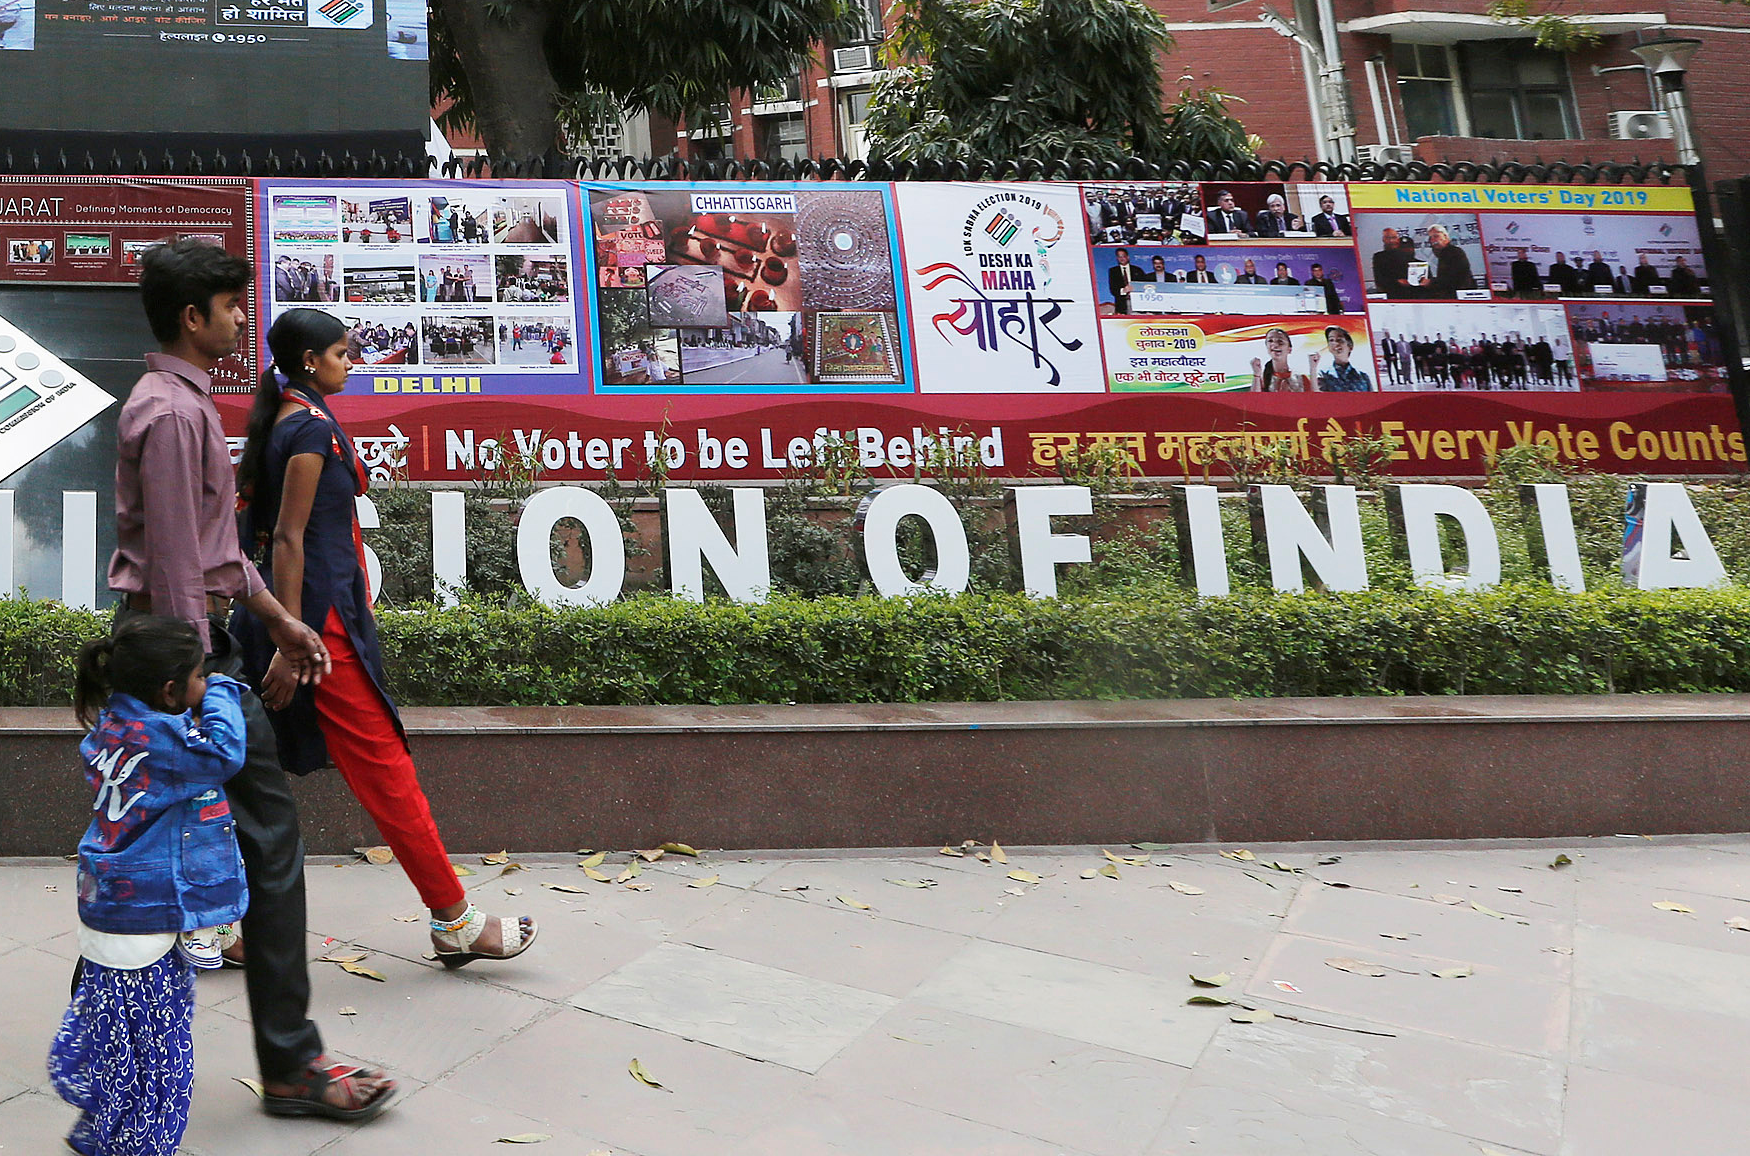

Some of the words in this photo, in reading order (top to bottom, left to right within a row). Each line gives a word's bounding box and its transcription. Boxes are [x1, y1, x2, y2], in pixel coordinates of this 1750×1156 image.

[221, 5, 241, 21] हो
[246, 6, 305, 22] शामिल
[228, 33, 267, 43] 1950
[696, 196, 792, 211] CHHATTISGARH
[977, 193, 1017, 212] ELECTION
[1018, 194, 1042, 211] 2019
[1395, 188, 1480, 203] National
[1560, 189, 1594, 207] Day
[1601, 189, 1647, 205] 2019
[76, 204, 116, 215] Defining
[119, 204, 162, 214] Moments
[165, 204, 175, 214] of
[177, 205, 232, 216] Democracy
[979, 254, 1011, 268] DESH
[1016, 253, 1033, 268] KA
[981, 271, 1036, 291] MAHA
[1139, 325, 1188, 337] लोकसभा
[1136, 338, 1165, 351] चुनाव
[1130, 357, 1148, 368] इस
[373, 376, 482, 393] DELHI
[1115, 372, 1134, 383] एक
[1138, 370, 1151, 381] भी
[1154, 370, 1180, 382] वोटर
[1183, 369, 1205, 388] छूटे
[1207, 372, 1225, 383] ना
[446, 429, 500, 471] No
[514, 428, 632, 471] Voter
[644, 431, 685, 471] to
[698, 428, 749, 470] be
[859, 427, 1004, 468] Behind
[1381, 421, 1499, 467] Every
[1506, 421, 1600, 461] Vote
[1610, 421, 1747, 463] Counts
[861, 483, 1094, 598] OF
[1180, 482, 1730, 597] INDIA
